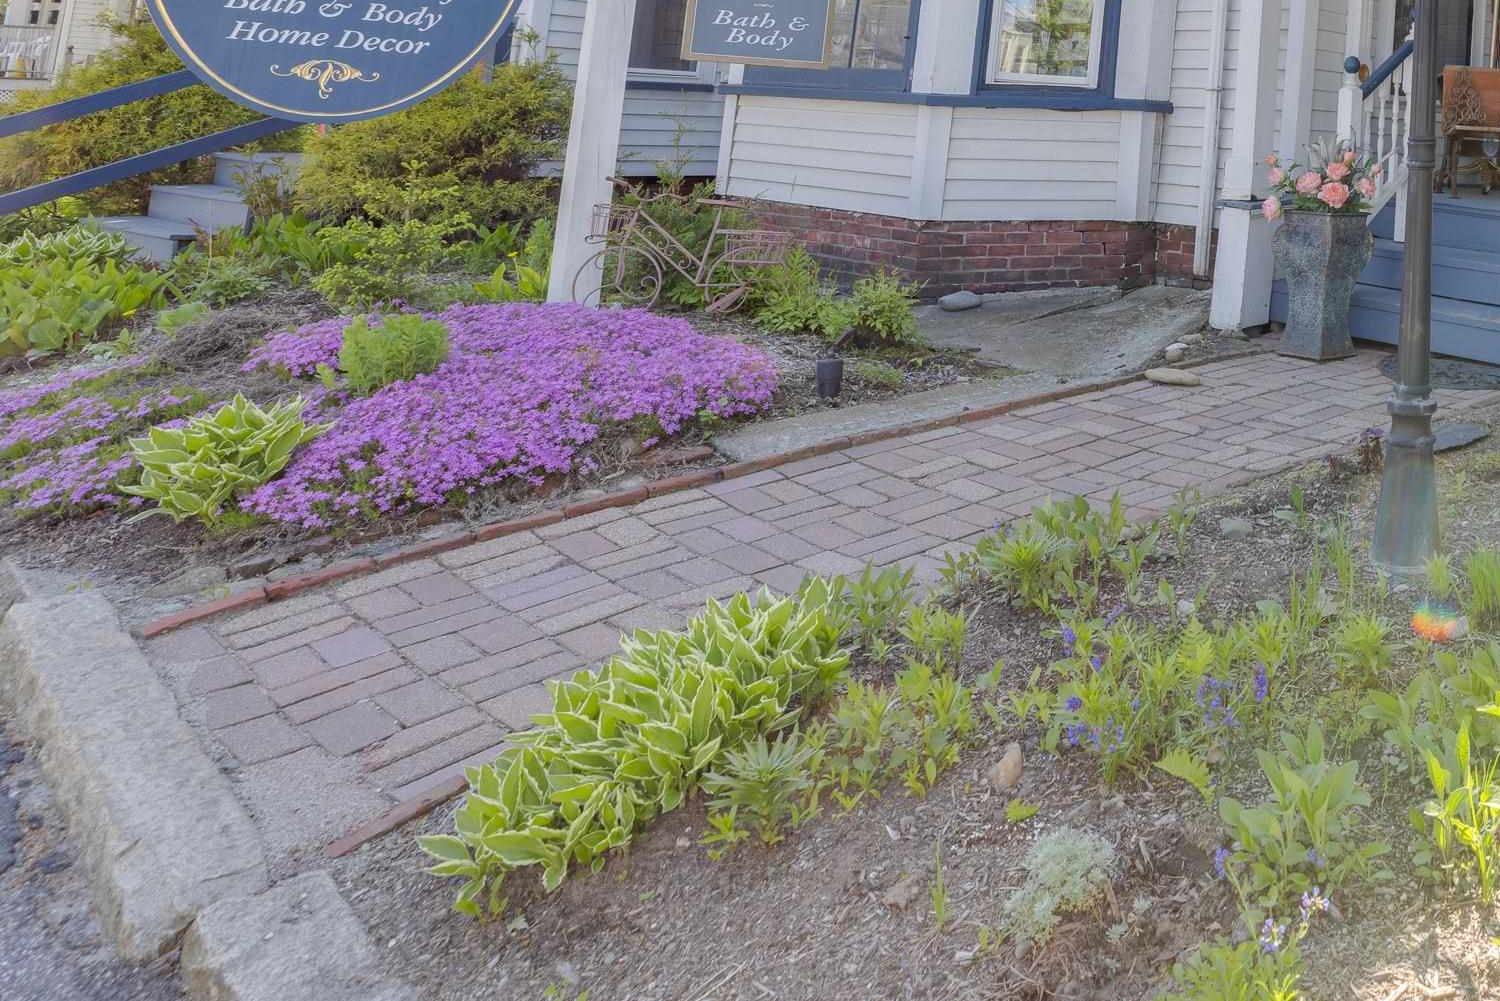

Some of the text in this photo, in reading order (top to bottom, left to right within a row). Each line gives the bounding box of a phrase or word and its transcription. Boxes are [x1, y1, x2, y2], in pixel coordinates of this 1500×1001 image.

[363, 2, 443, 30] Body
[712, 9, 809, 31] Bath &
[226, 20, 431, 55] Home Decor
[725, 28, 794, 51] Body
